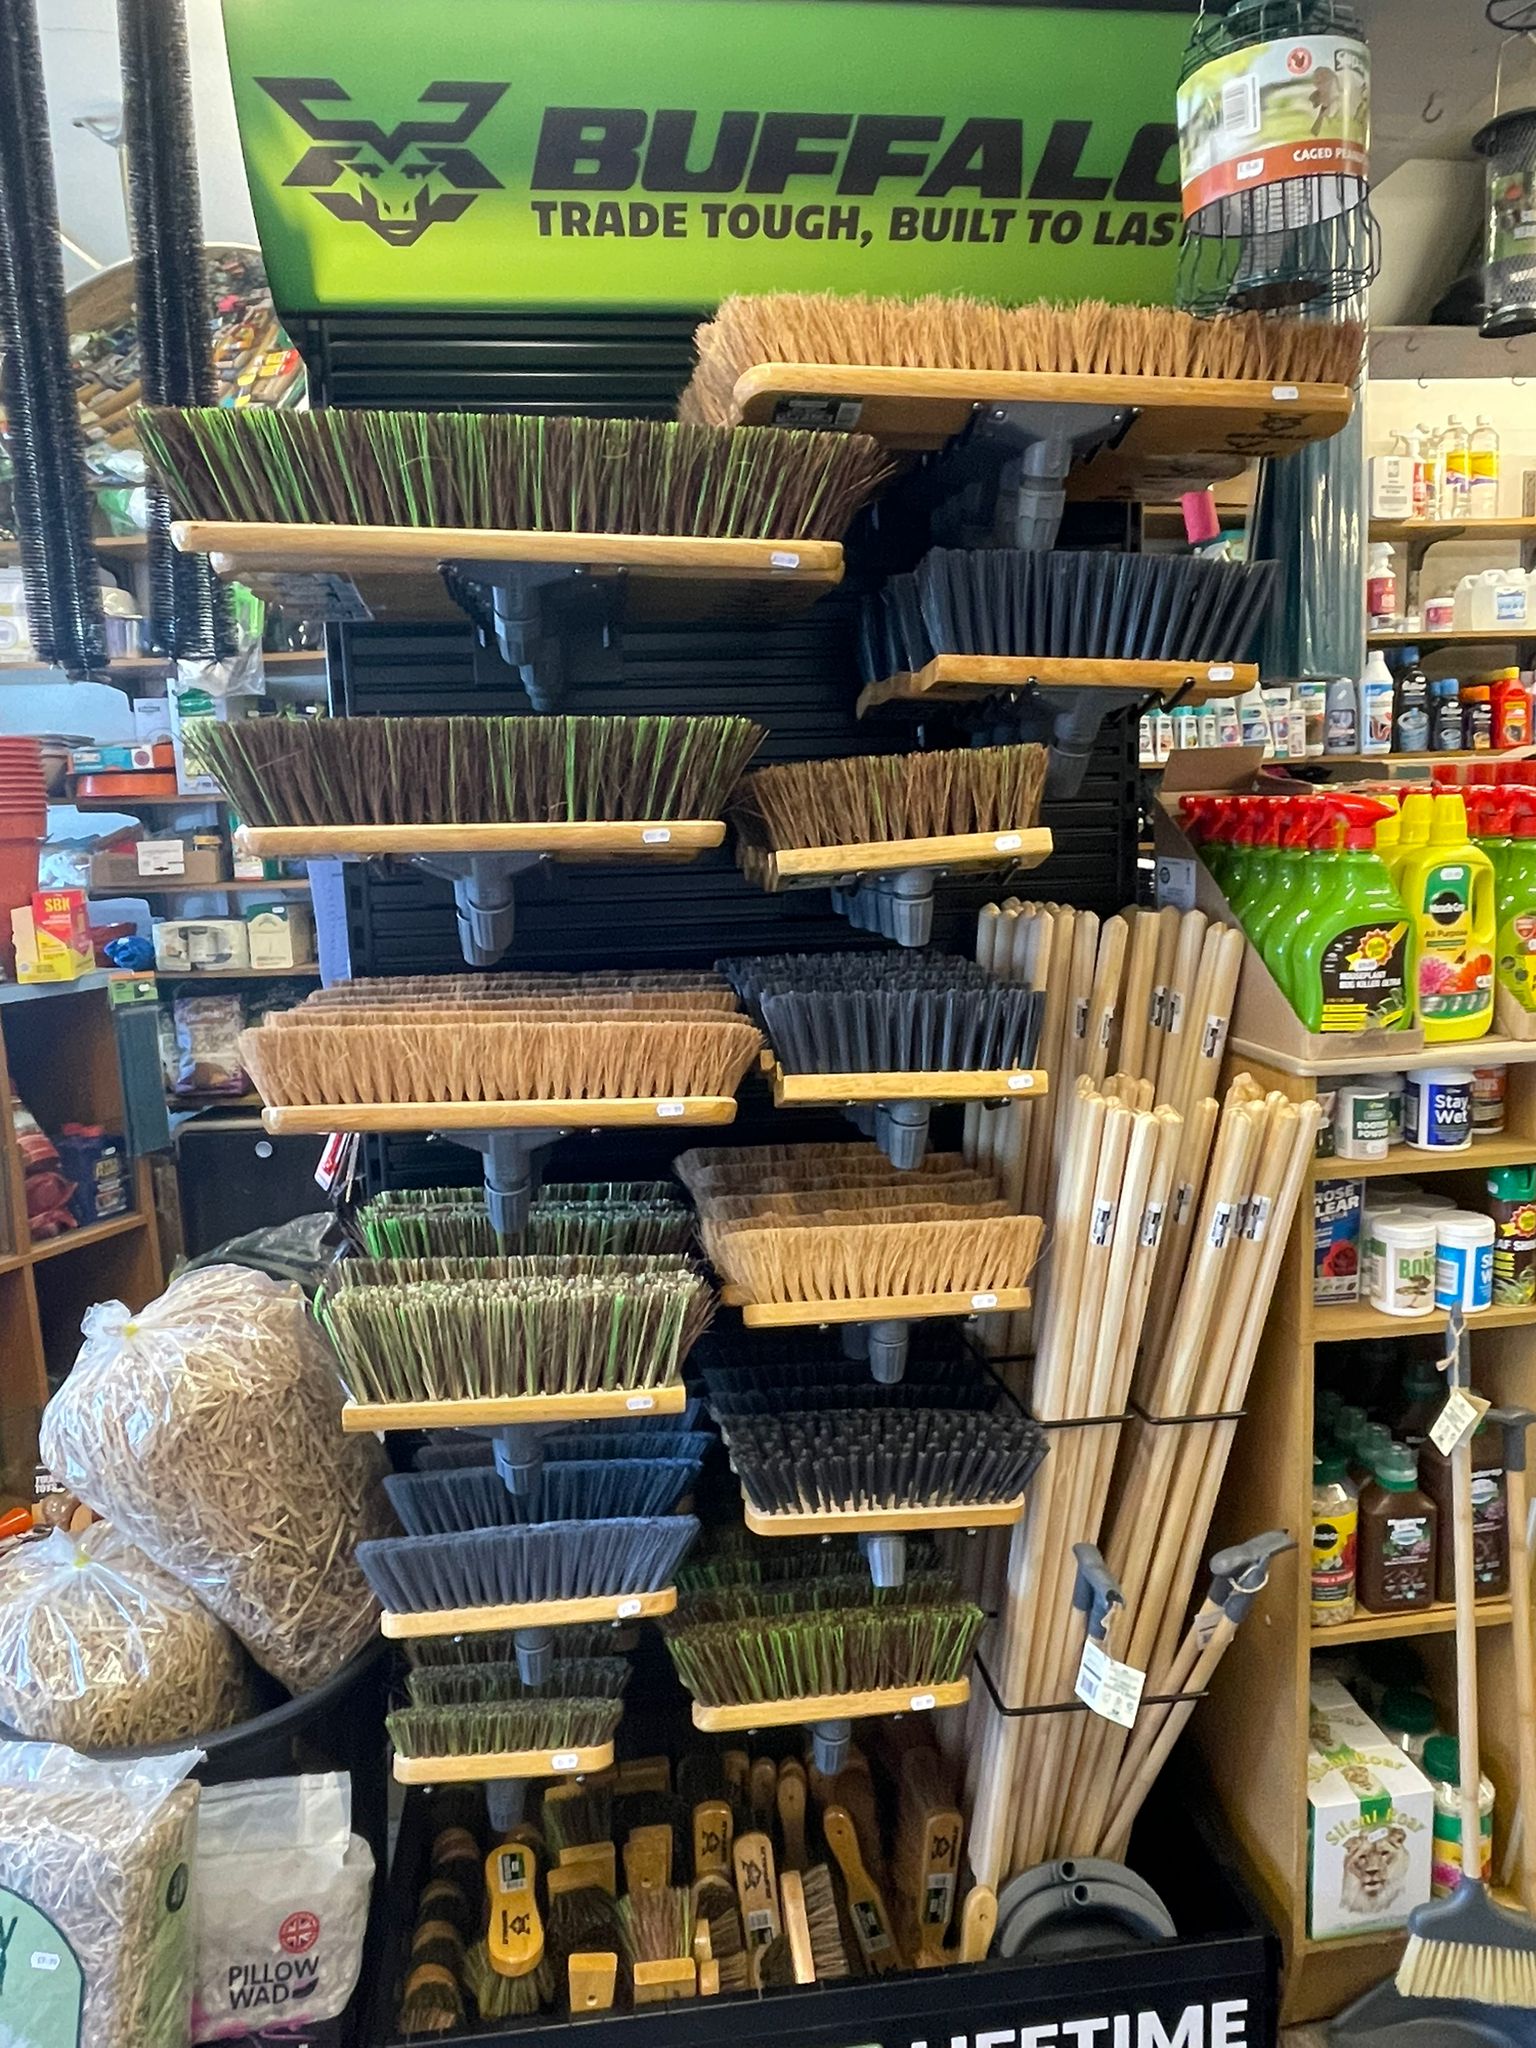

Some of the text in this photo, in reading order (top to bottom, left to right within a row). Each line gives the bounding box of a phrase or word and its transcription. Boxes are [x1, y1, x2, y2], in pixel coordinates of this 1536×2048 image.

[530, 106, 1182, 202] BUFFALO
[1292, 147, 1333, 162] CAGED
[530, 201, 1185, 248] TRADE TOUGH, BUILT TO LAS
[1434, 1109, 1468, 1124] Wet
[1315, 1195, 1360, 1218] LEAR
[229, 1956, 320, 1987] PILLOW
[229, 1983, 290, 2010] WAD
[911, 2000, 1248, 2048] TIME
